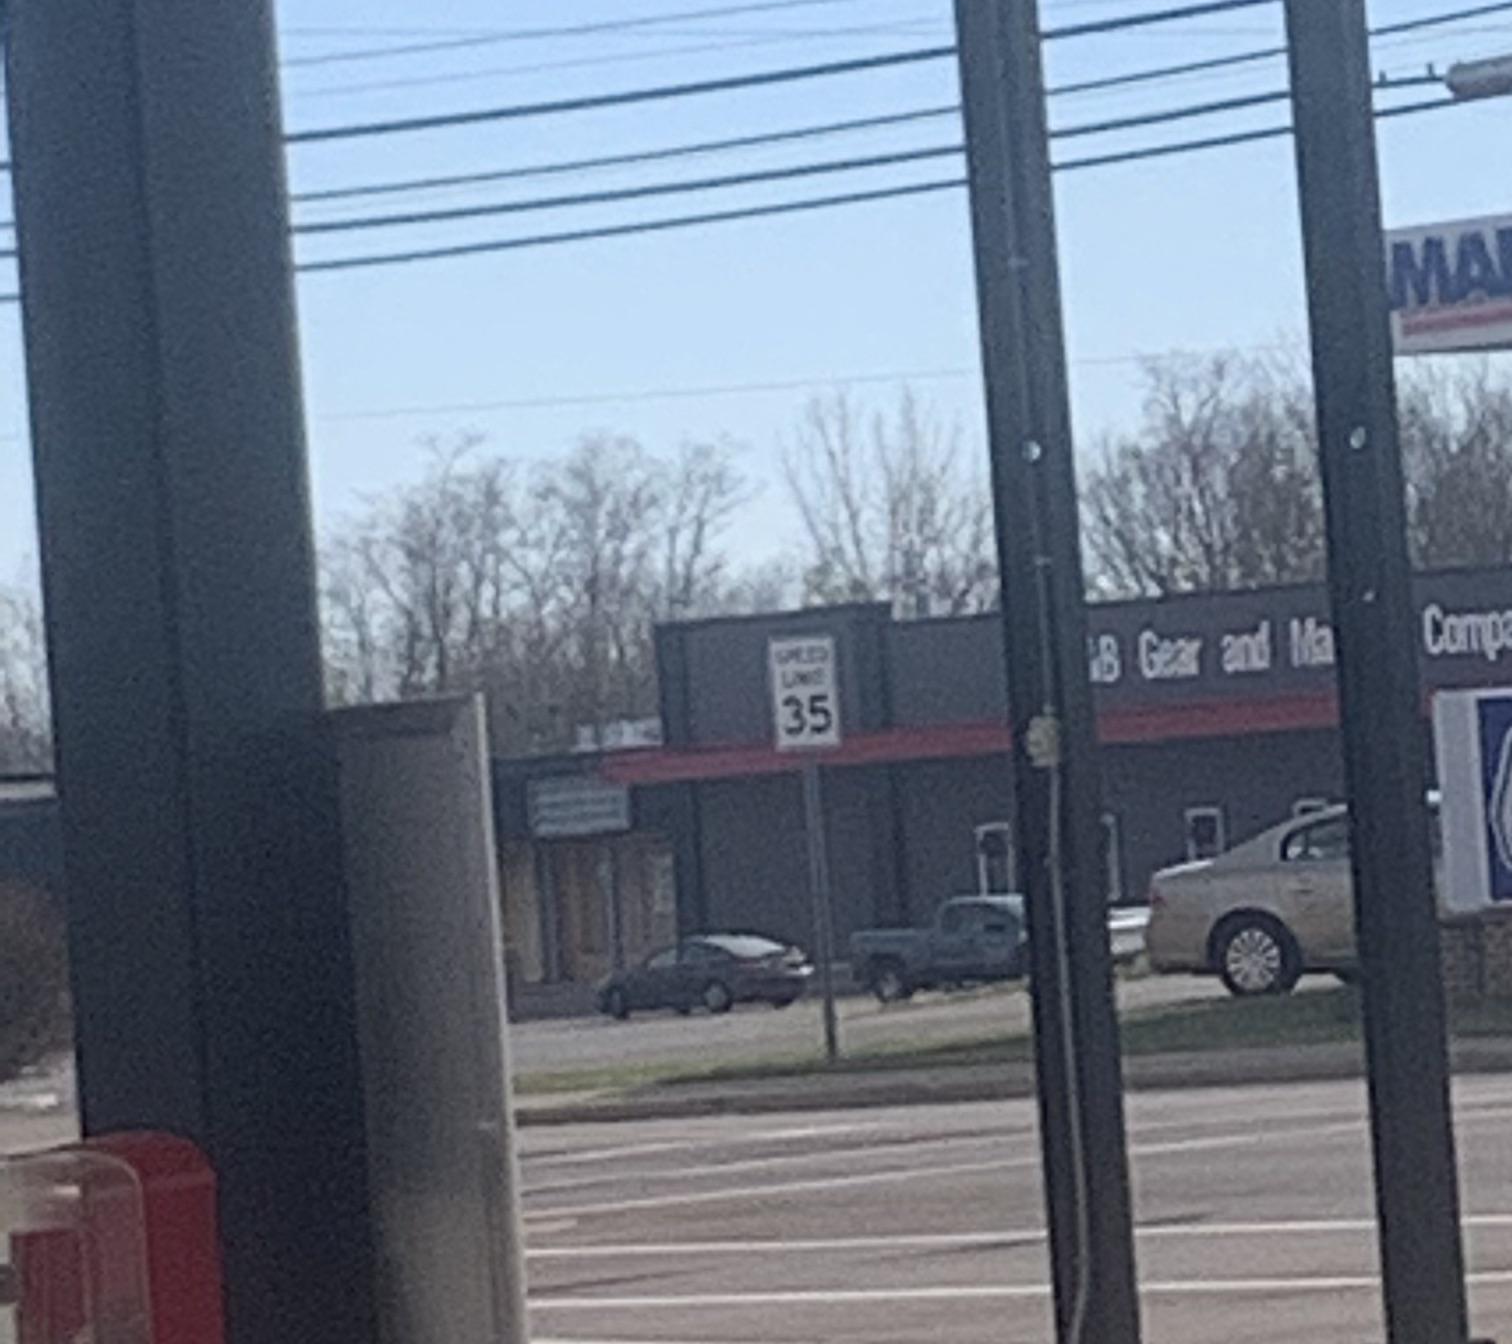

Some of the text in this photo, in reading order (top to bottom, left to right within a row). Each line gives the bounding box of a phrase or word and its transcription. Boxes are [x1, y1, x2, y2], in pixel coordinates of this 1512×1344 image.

[1138, 630, 1201, 679] Gear
[1220, 620, 1271, 674] and
[781, 693, 833, 735] 35
